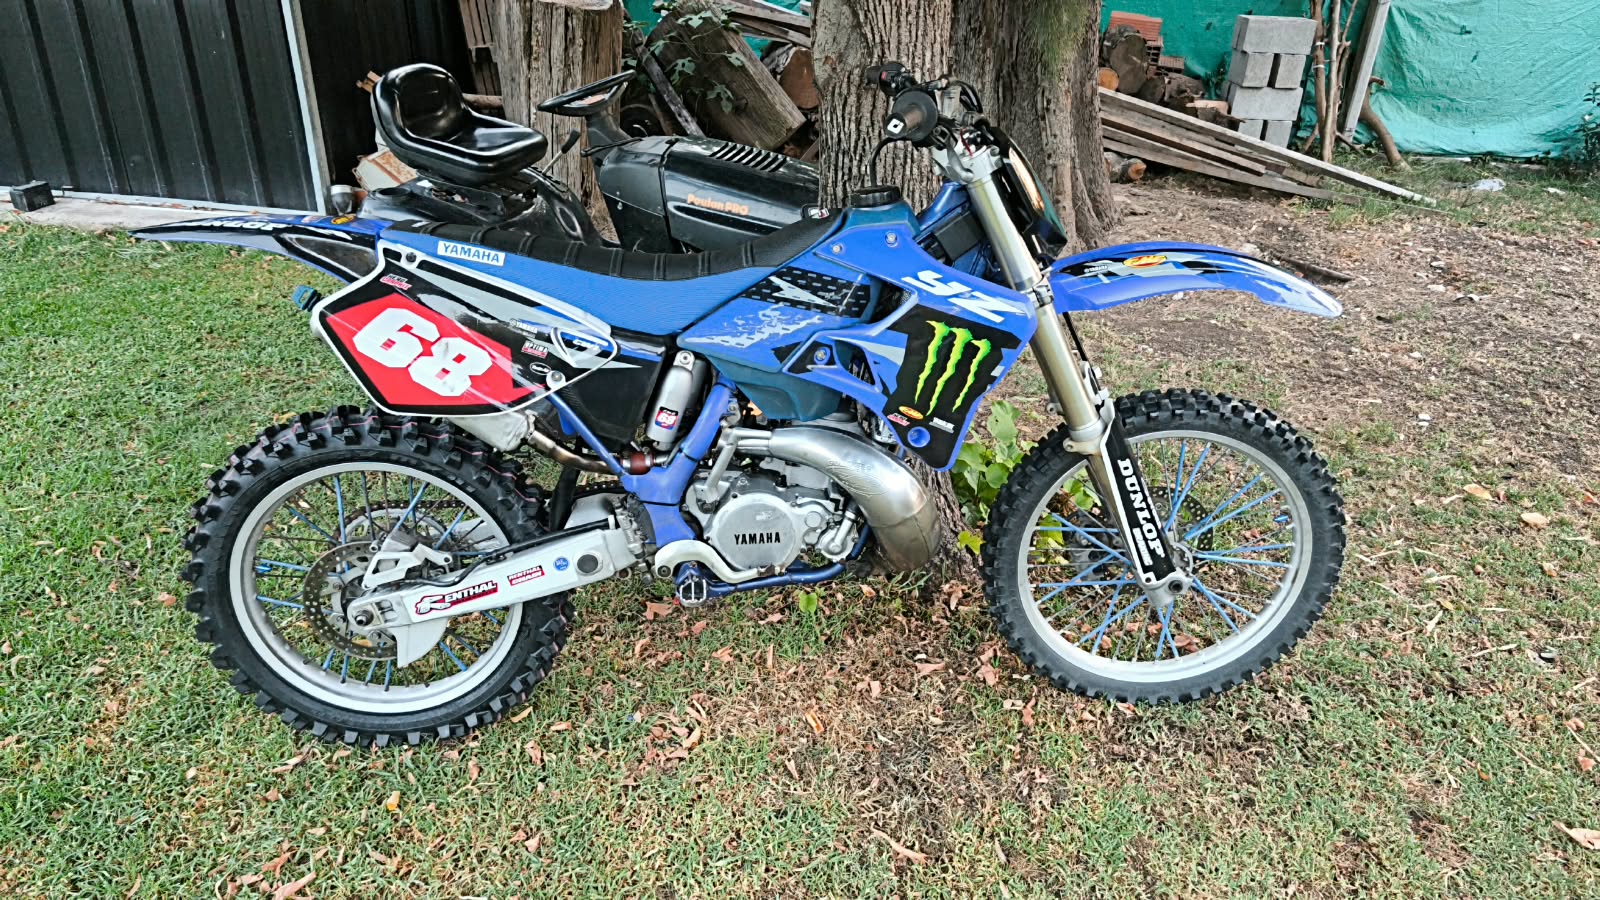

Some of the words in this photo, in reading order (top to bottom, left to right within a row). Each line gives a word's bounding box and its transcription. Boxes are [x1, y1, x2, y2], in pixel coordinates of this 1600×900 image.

[688, 194, 725, 211] Poulan
[725, 202, 749, 216] PRO
[441, 242, 502, 263] YAMAHA
[353, 308, 492, 396] 68
[1117, 458, 1165, 558] DUNLOP
[734, 532, 781, 545] YAMAHA
